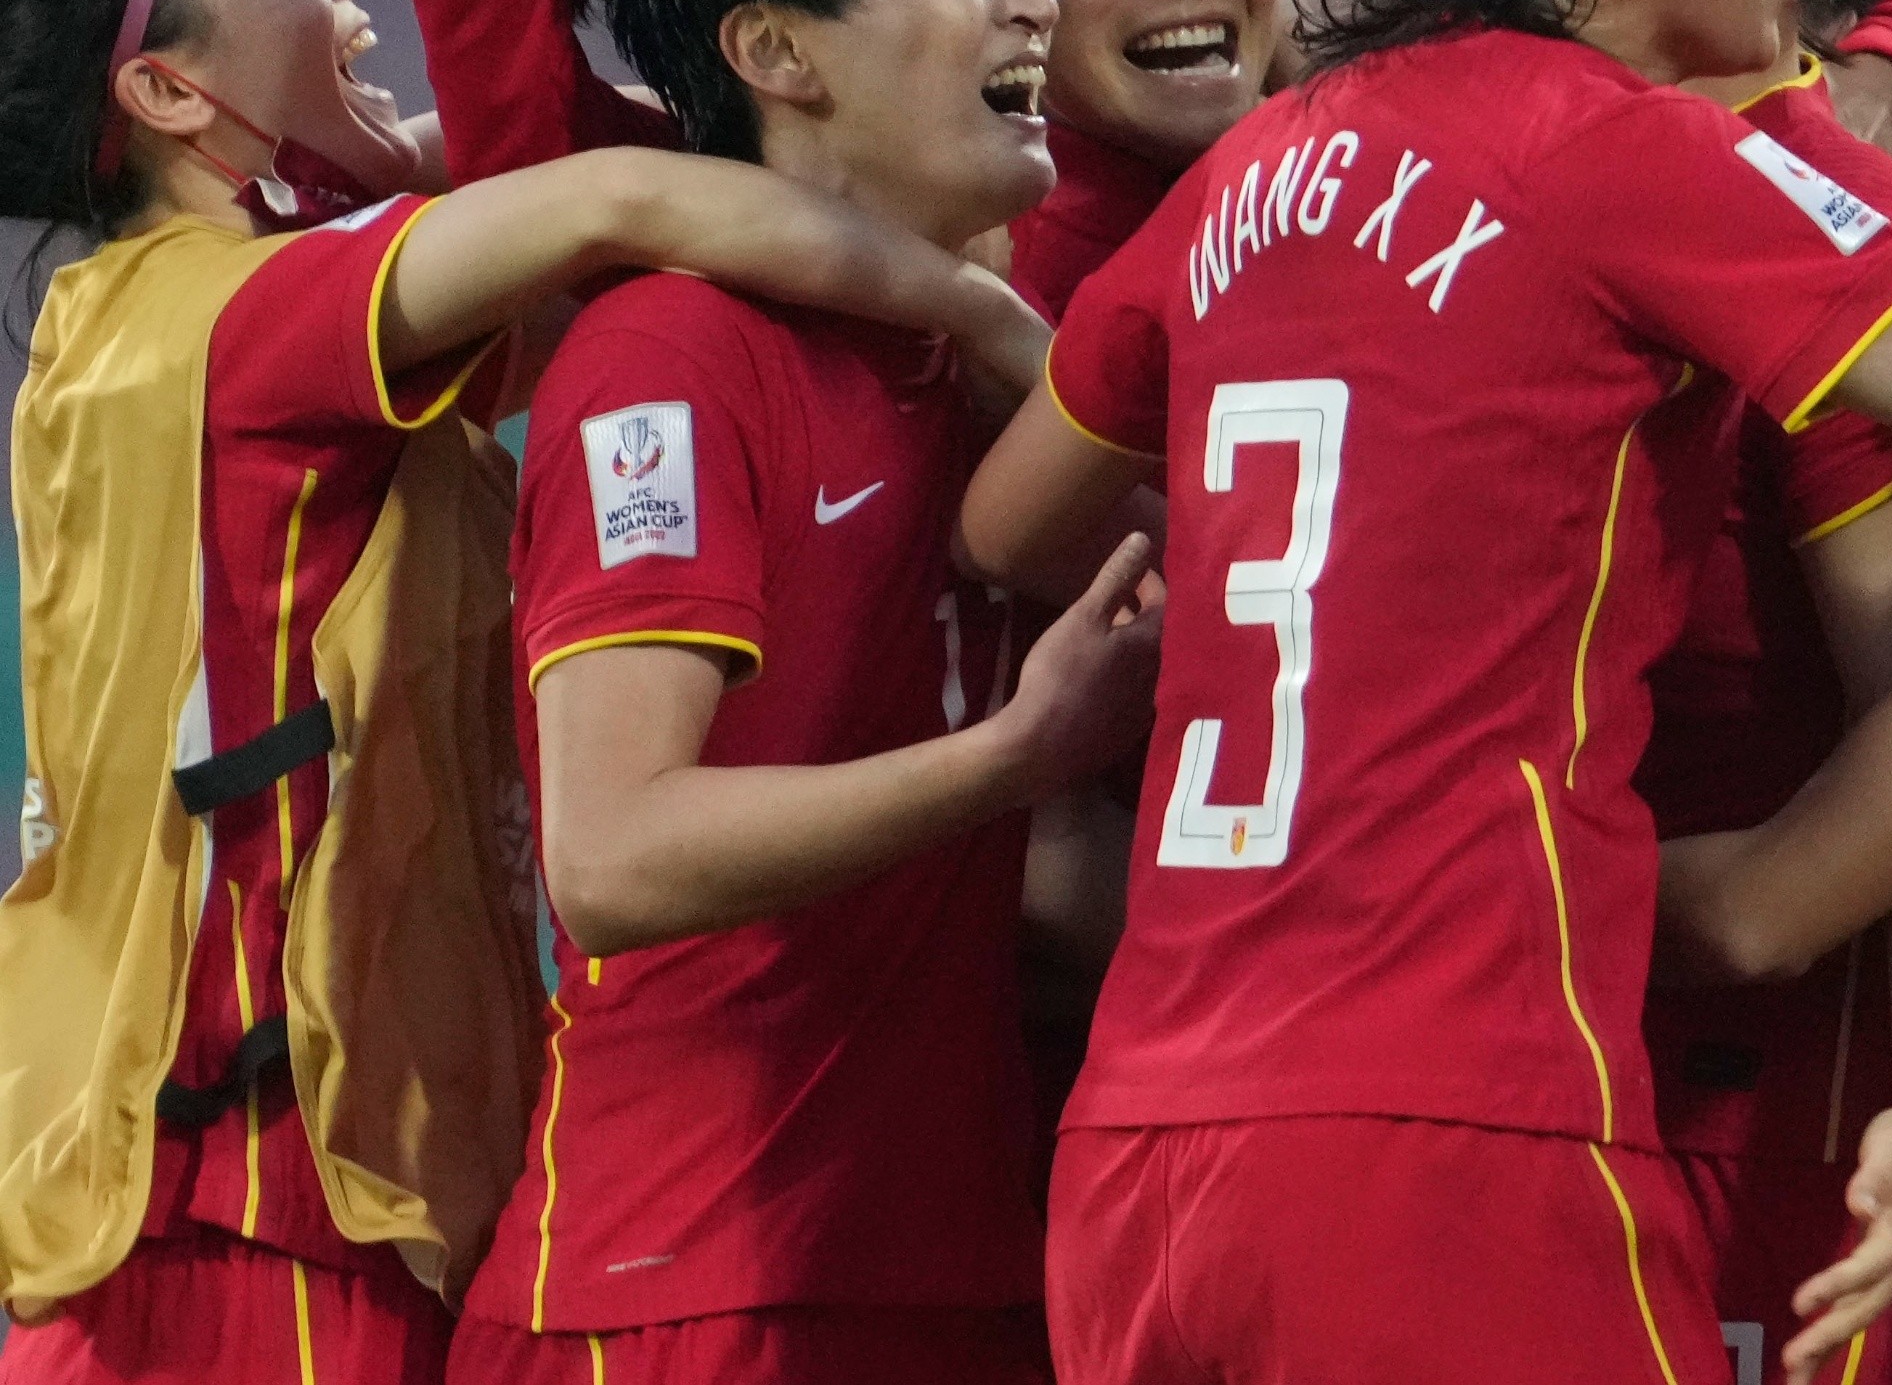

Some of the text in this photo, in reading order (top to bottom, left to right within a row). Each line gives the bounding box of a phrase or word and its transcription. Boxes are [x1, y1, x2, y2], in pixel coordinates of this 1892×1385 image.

[1189, 130, 1505, 321] WANG X X
[627, 487, 655, 502] AFC
[605, 500, 680, 524] WOMEN'S
[605, 515, 648, 542] ASIAN
[1157, 379, 1350, 868] 3
